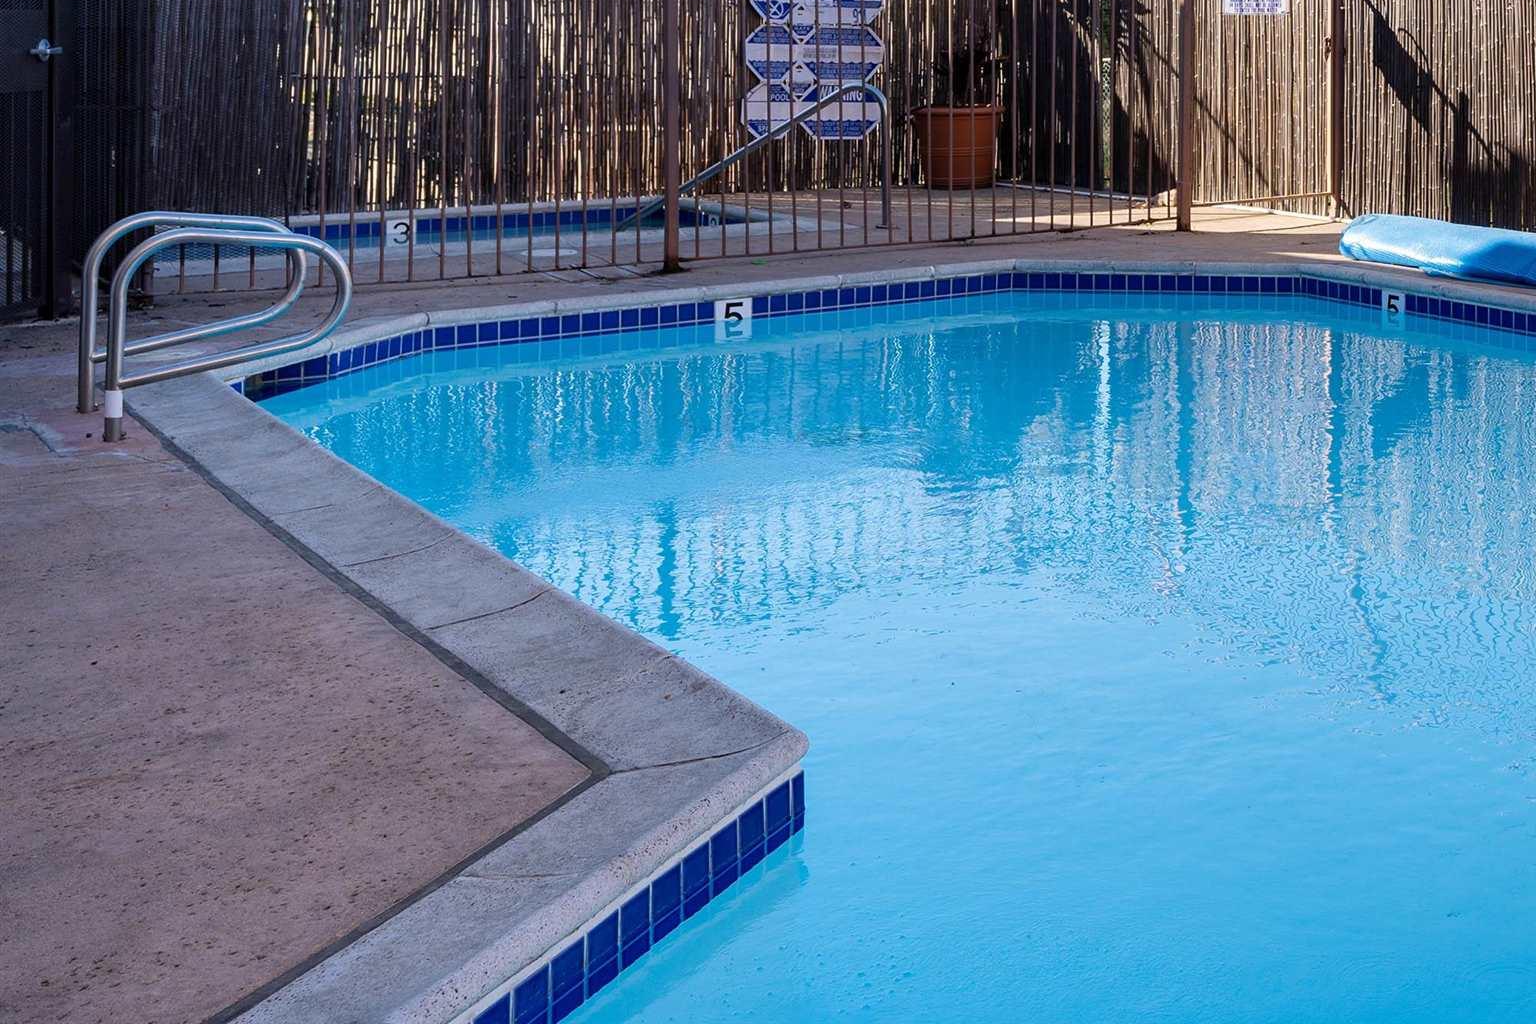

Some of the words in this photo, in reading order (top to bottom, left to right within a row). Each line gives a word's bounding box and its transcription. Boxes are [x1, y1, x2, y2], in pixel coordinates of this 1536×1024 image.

[820, 85, 863, 101] WAING
[393, 222, 410, 244] 3
[724, 302, 743, 321] 5
[1387, 294, 1399, 313] 5
